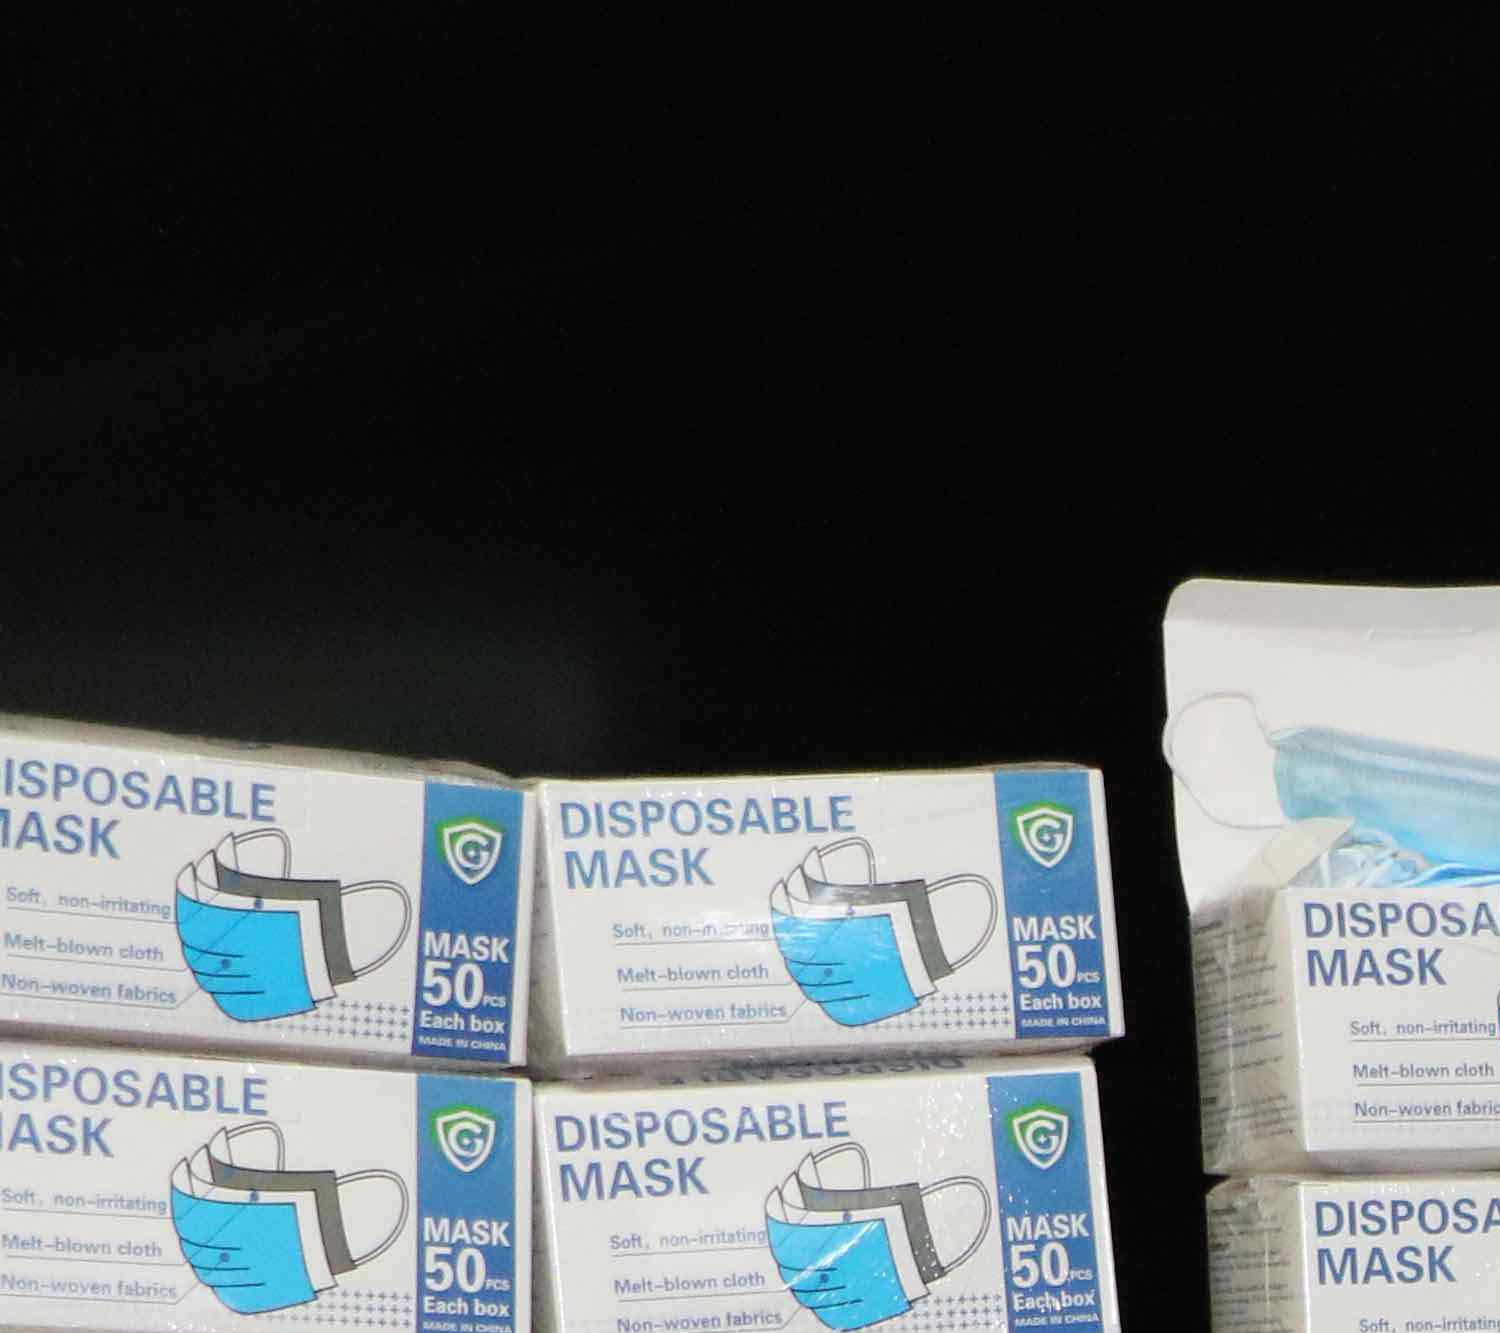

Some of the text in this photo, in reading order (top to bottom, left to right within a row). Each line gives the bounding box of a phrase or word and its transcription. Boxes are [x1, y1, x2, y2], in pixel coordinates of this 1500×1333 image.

[0, 757, 277, 822] ISPOSABLE
[559, 794, 856, 839] DISPOSABLE
[564, 846, 713, 890] MASK
[423, 929, 510, 964] MASK
[1012, 914, 1097, 942] MASK
[421, 958, 484, 1010] 50
[1015, 942, 1077, 989] 50
[1307, 948, 1445, 986] MASK
[1019, 991, 1103, 1011] Each box
[1352, 1063, 1494, 1079] Melt-blown cloth
[554, 1100, 851, 1152] DISPOSABLE
[1354, 1102, 1451, 1118] Non-woven
[0, 1112, 114, 1158] ASK
[560, 1156, 708, 1203] MASK
[423, 1216, 510, 1247] MASK
[1006, 1213, 1090, 1242] MASK
[424, 1244, 485, 1294] 50
[1009, 1241, 1070, 1289] 50
[1318, 1245, 1455, 1285] MASK
[1012, 1289, 1095, 1311] Each box
